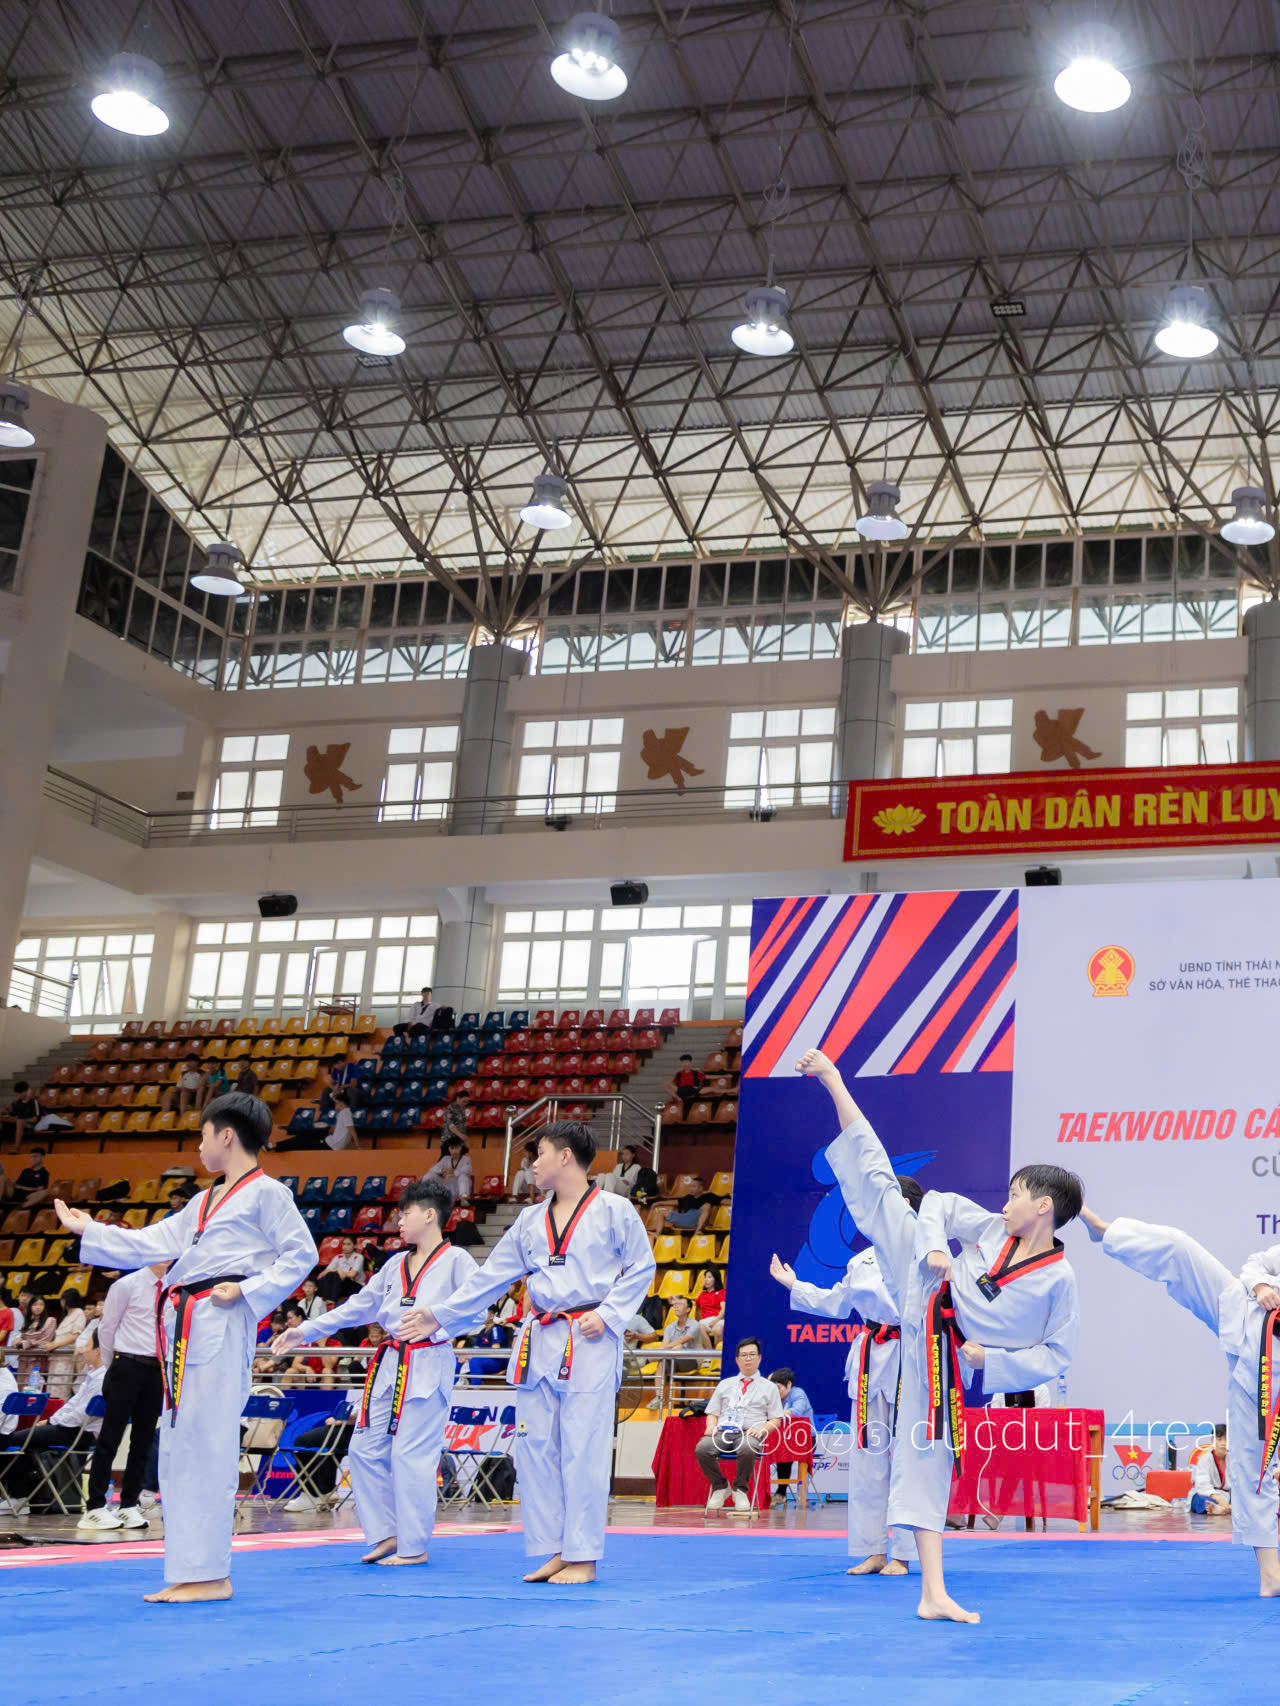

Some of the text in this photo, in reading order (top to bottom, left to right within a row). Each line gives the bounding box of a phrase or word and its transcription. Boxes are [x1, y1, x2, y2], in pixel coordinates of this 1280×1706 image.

[937, 793, 1032, 835] TOÀN
[1045, 789, 1121, 831] DÂN
[1134, 784, 1209, 827] RÈN
[1179, 961, 1212, 973] UBND
[1245, 957, 1272, 971] THÁI
[1149, 976, 1168, 991] SỞ
[1170, 977, 1193, 990] VĂN
[1057, 1107, 1237, 1143] TAEKWONDO
[786, 1324, 864, 1343] TAEKW
